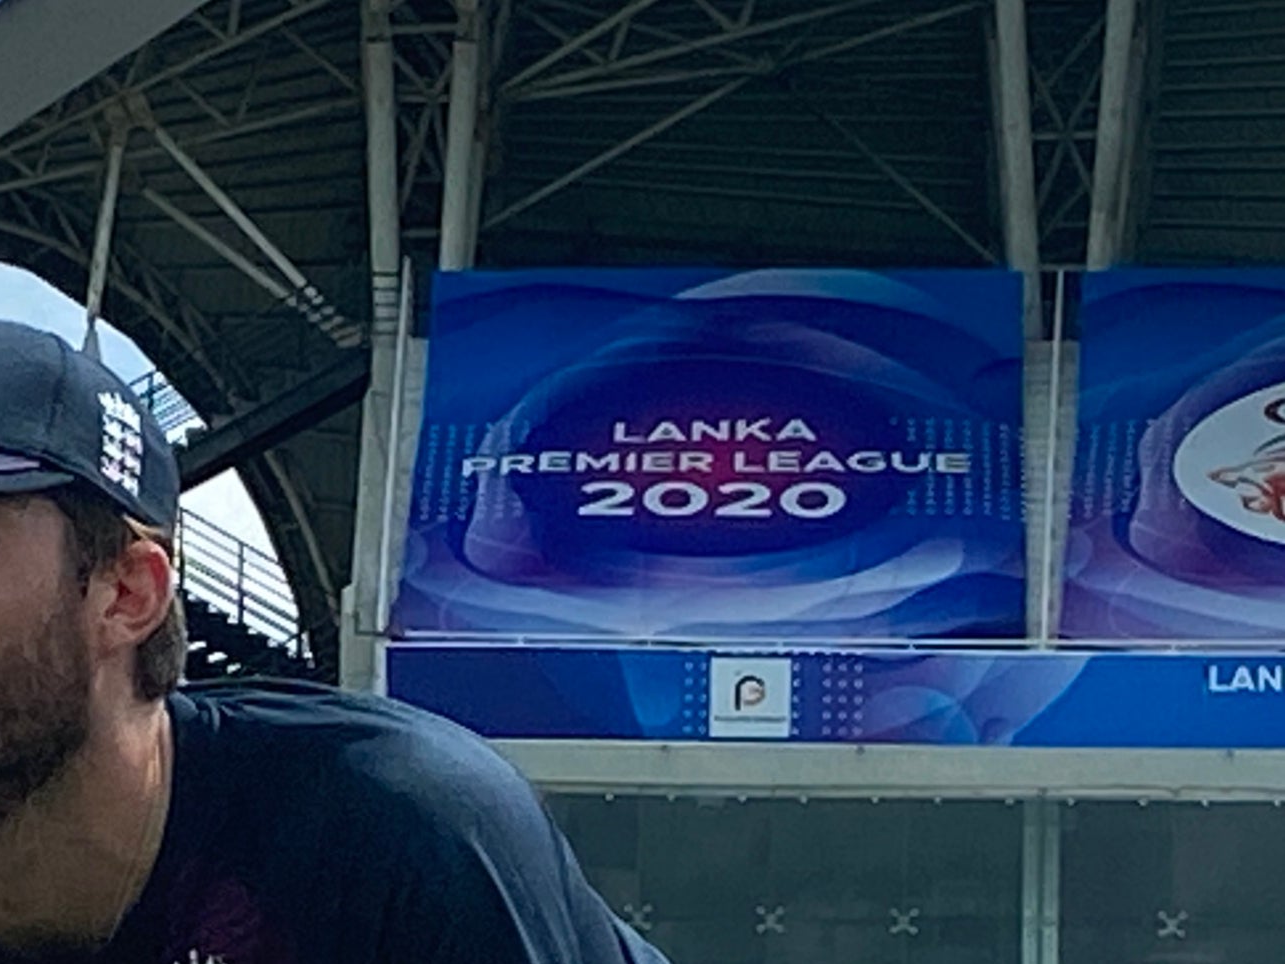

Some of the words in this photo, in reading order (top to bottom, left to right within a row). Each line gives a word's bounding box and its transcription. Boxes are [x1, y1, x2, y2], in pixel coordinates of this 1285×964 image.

[614, 420, 818, 442] LANKA
[462, 452, 713, 477] PREMIER
[734, 453, 971, 474] LEAGUE
[578, 482, 847, 518] 2020
[1208, 665, 1283, 692] LAN
